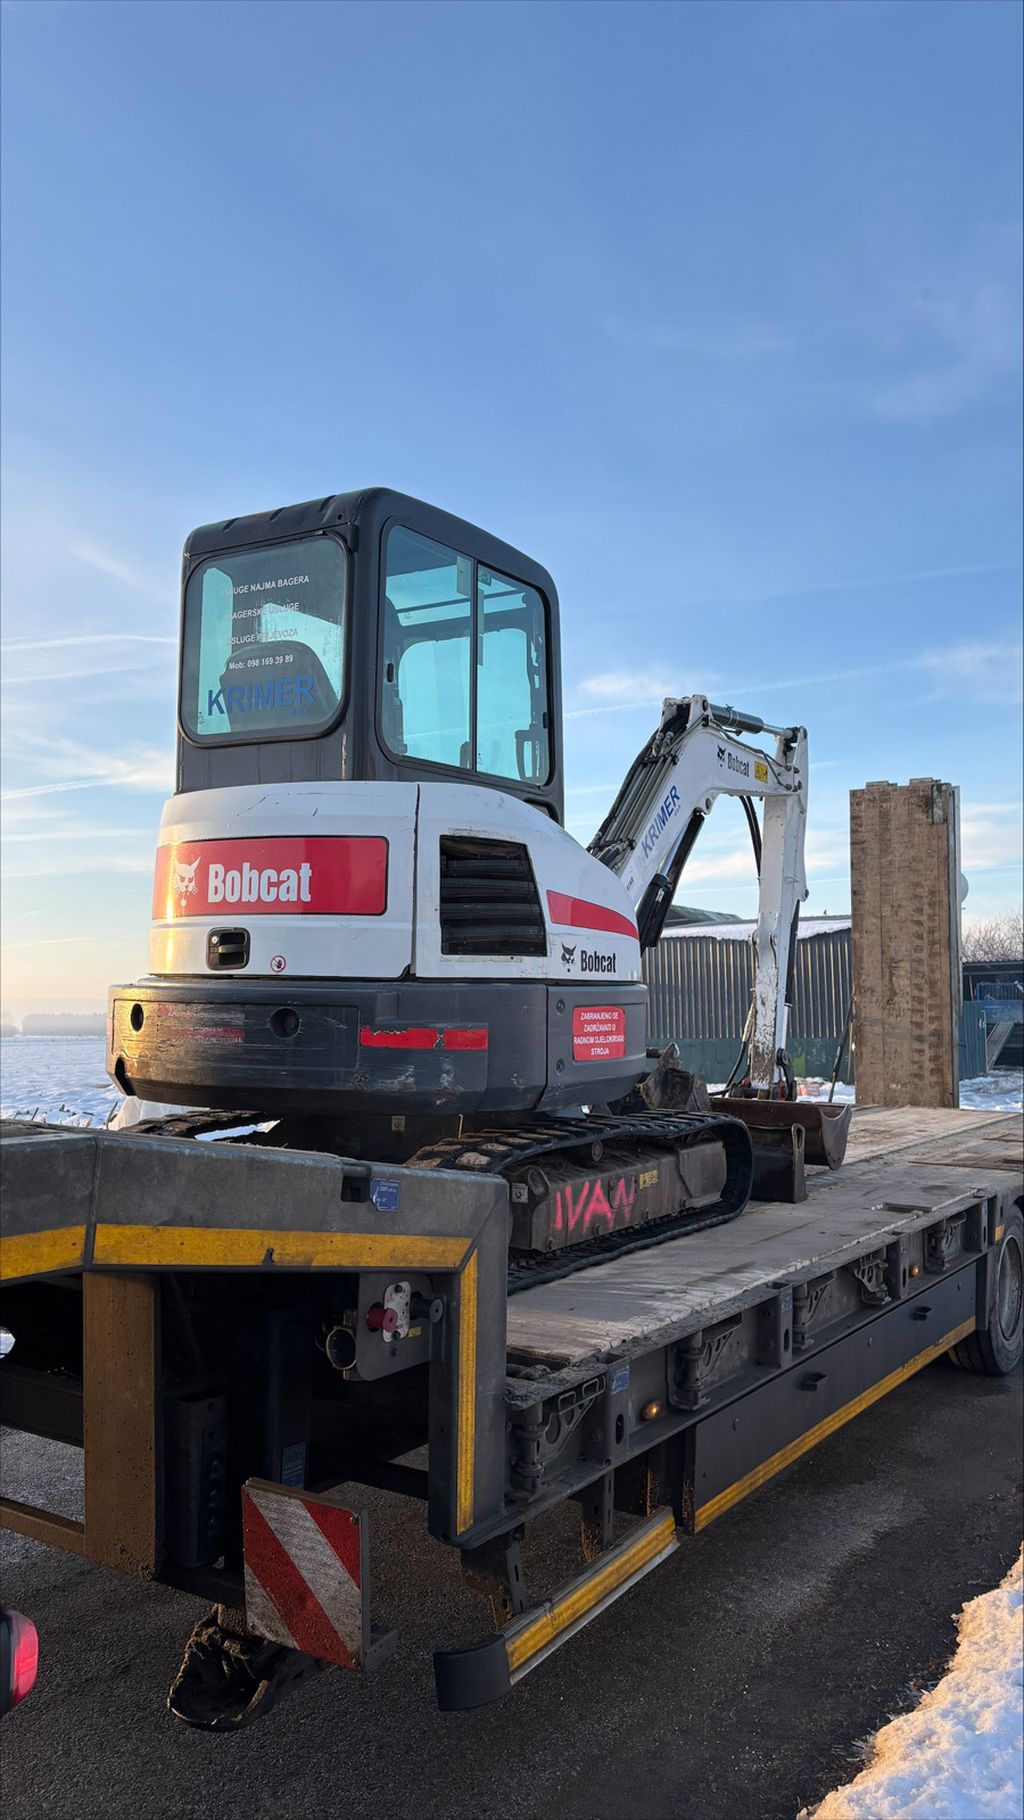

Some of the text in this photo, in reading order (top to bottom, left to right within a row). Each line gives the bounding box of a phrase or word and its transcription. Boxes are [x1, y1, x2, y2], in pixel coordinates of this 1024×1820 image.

[220, 575, 310, 597] UGE NAJMA BAGERA
[226, 606, 269, 620] AGERSKE
[226, 634, 256, 645] SLUGE
[229, 660, 246, 670] Mob:
[247, 658, 260, 668] 098
[261, 656, 274, 666] 169
[274, 655, 284, 664] 39
[207, 674, 315, 716] KRIMER
[727, 752, 750, 778] Bobcat
[641, 784, 681, 859] KRIMER
[207, 862, 313, 903] Bobcat
[580, 949, 617, 974] Bobcat
[580, 1011, 619, 1020] ZABRANJENO SE
[574, 1036, 595, 1044] RADNOM
[554, 1173, 636, 1236] IVAN
